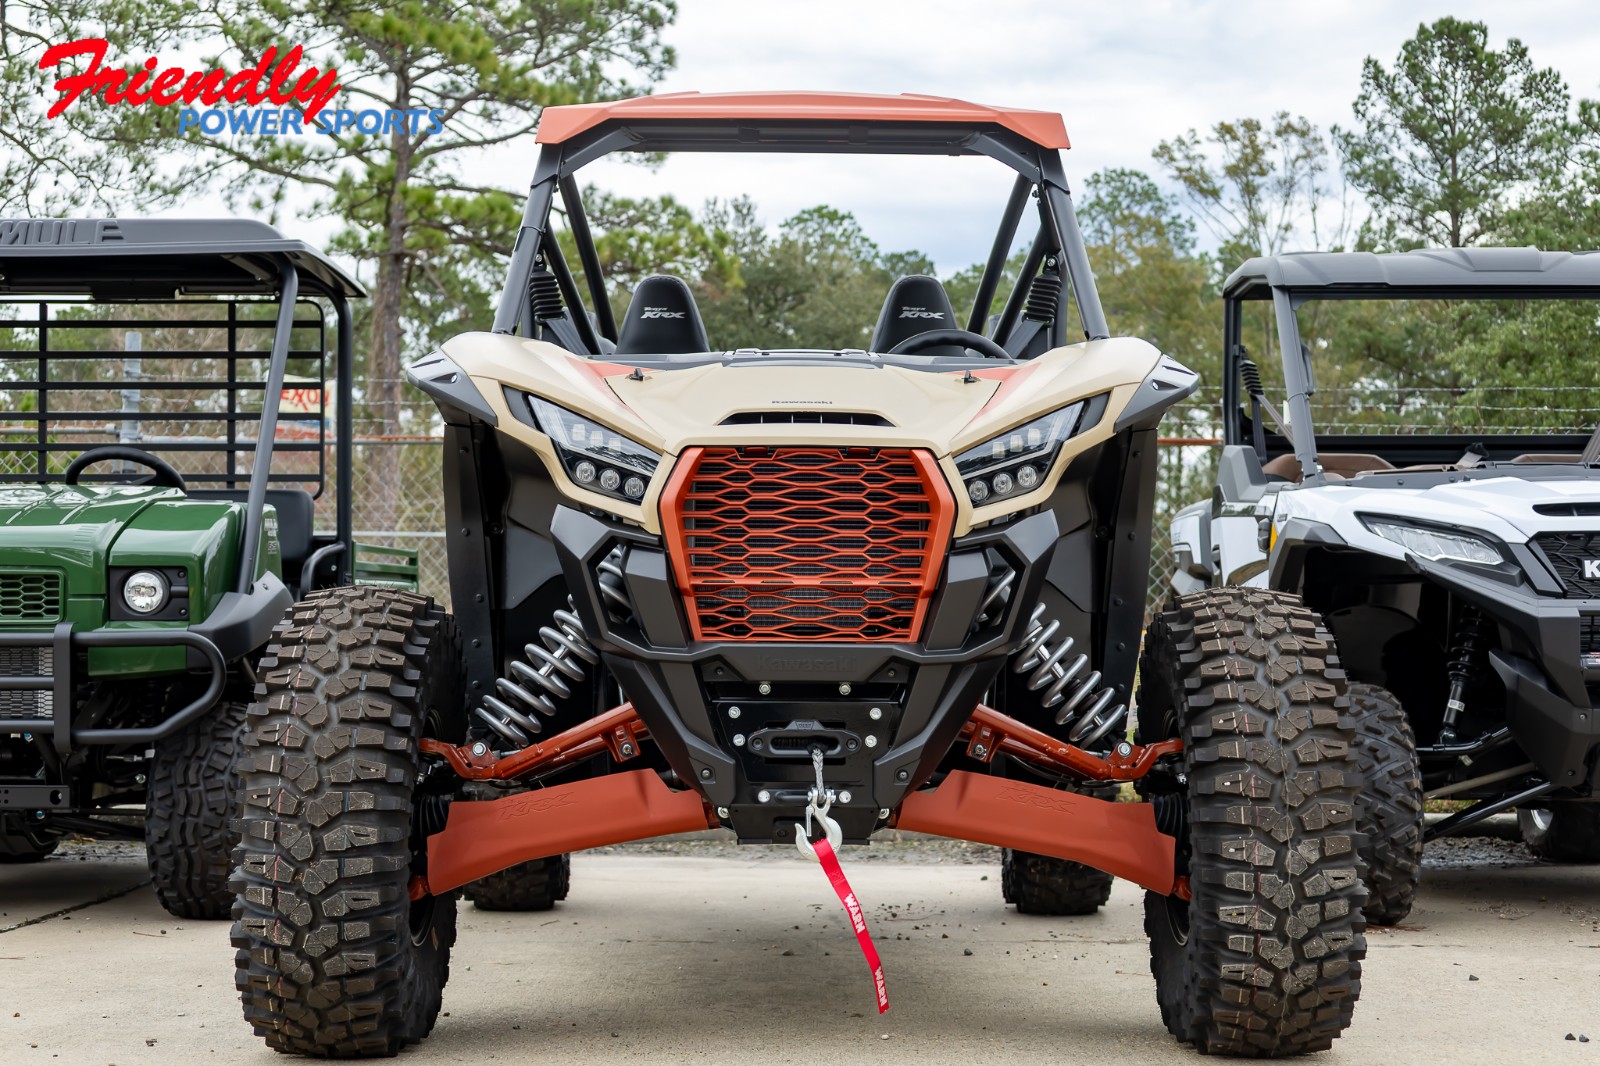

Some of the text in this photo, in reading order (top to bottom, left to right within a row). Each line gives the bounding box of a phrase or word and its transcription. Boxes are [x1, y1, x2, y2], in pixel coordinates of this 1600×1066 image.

[0, 219, 125, 245] MULE
[640, 311, 686, 319] KRX
[899, 311, 945, 319] KRX
[757, 653, 858, 673] Kawasaki
[844, 892, 866, 934] WARN
[874, 966, 888, 1008] WARN
